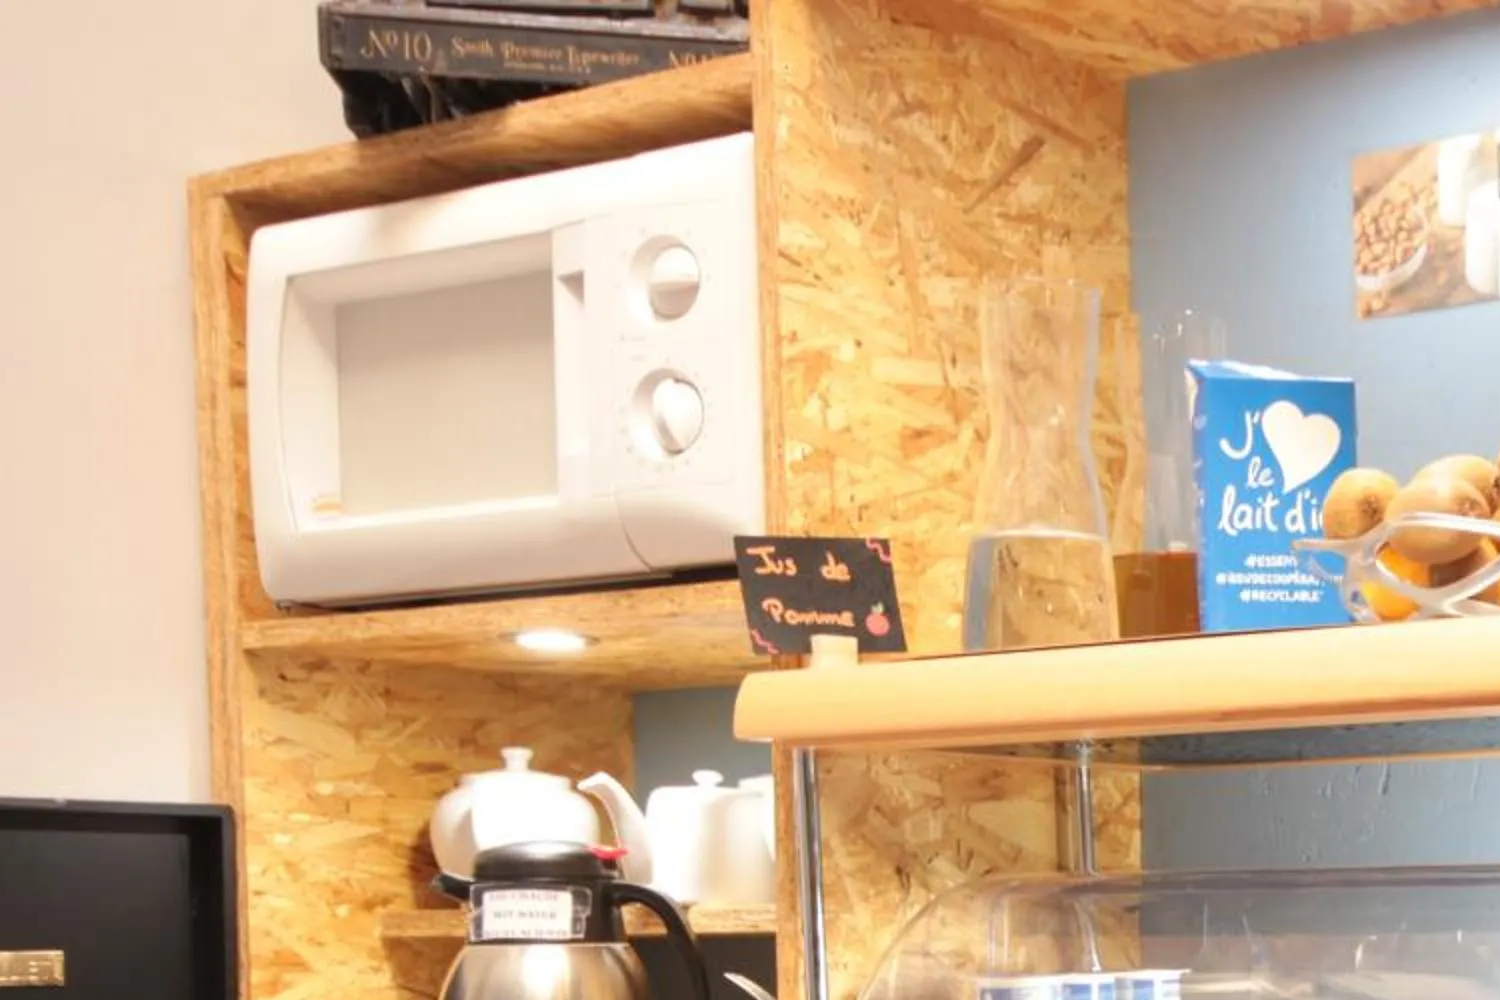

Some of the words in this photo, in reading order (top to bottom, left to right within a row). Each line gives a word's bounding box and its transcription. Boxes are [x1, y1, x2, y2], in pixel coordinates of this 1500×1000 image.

[1247, 456, 1275, 489] le
[1217, 484, 1280, 537] lait
[1284, 489, 1323, 535] d'i
[746, 546, 797, 577] Jus
[761, 598, 856, 628] Pomme
